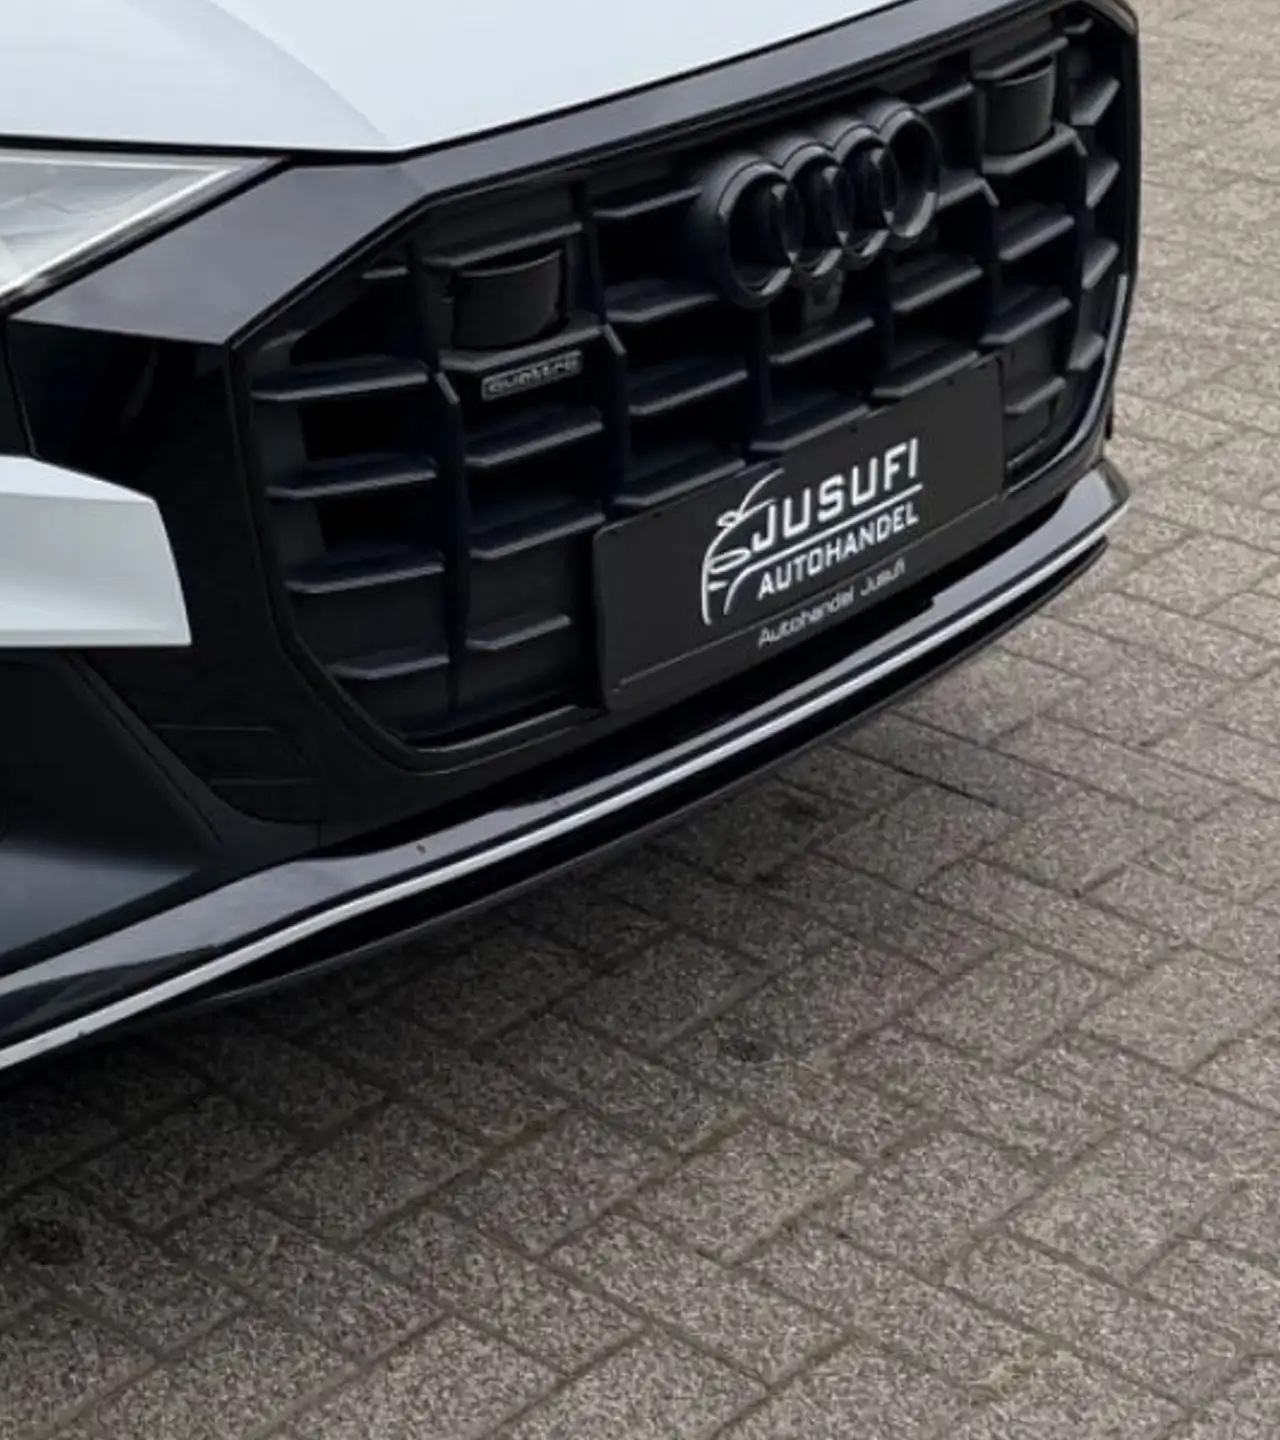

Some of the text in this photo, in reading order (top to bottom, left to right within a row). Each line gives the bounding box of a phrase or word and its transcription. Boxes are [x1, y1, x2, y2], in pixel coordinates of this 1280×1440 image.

[752, 438, 919, 552] JUSUFI
[757, 501, 920, 600] AUTOHANDEL
[758, 588, 855, 647] Autohandel
